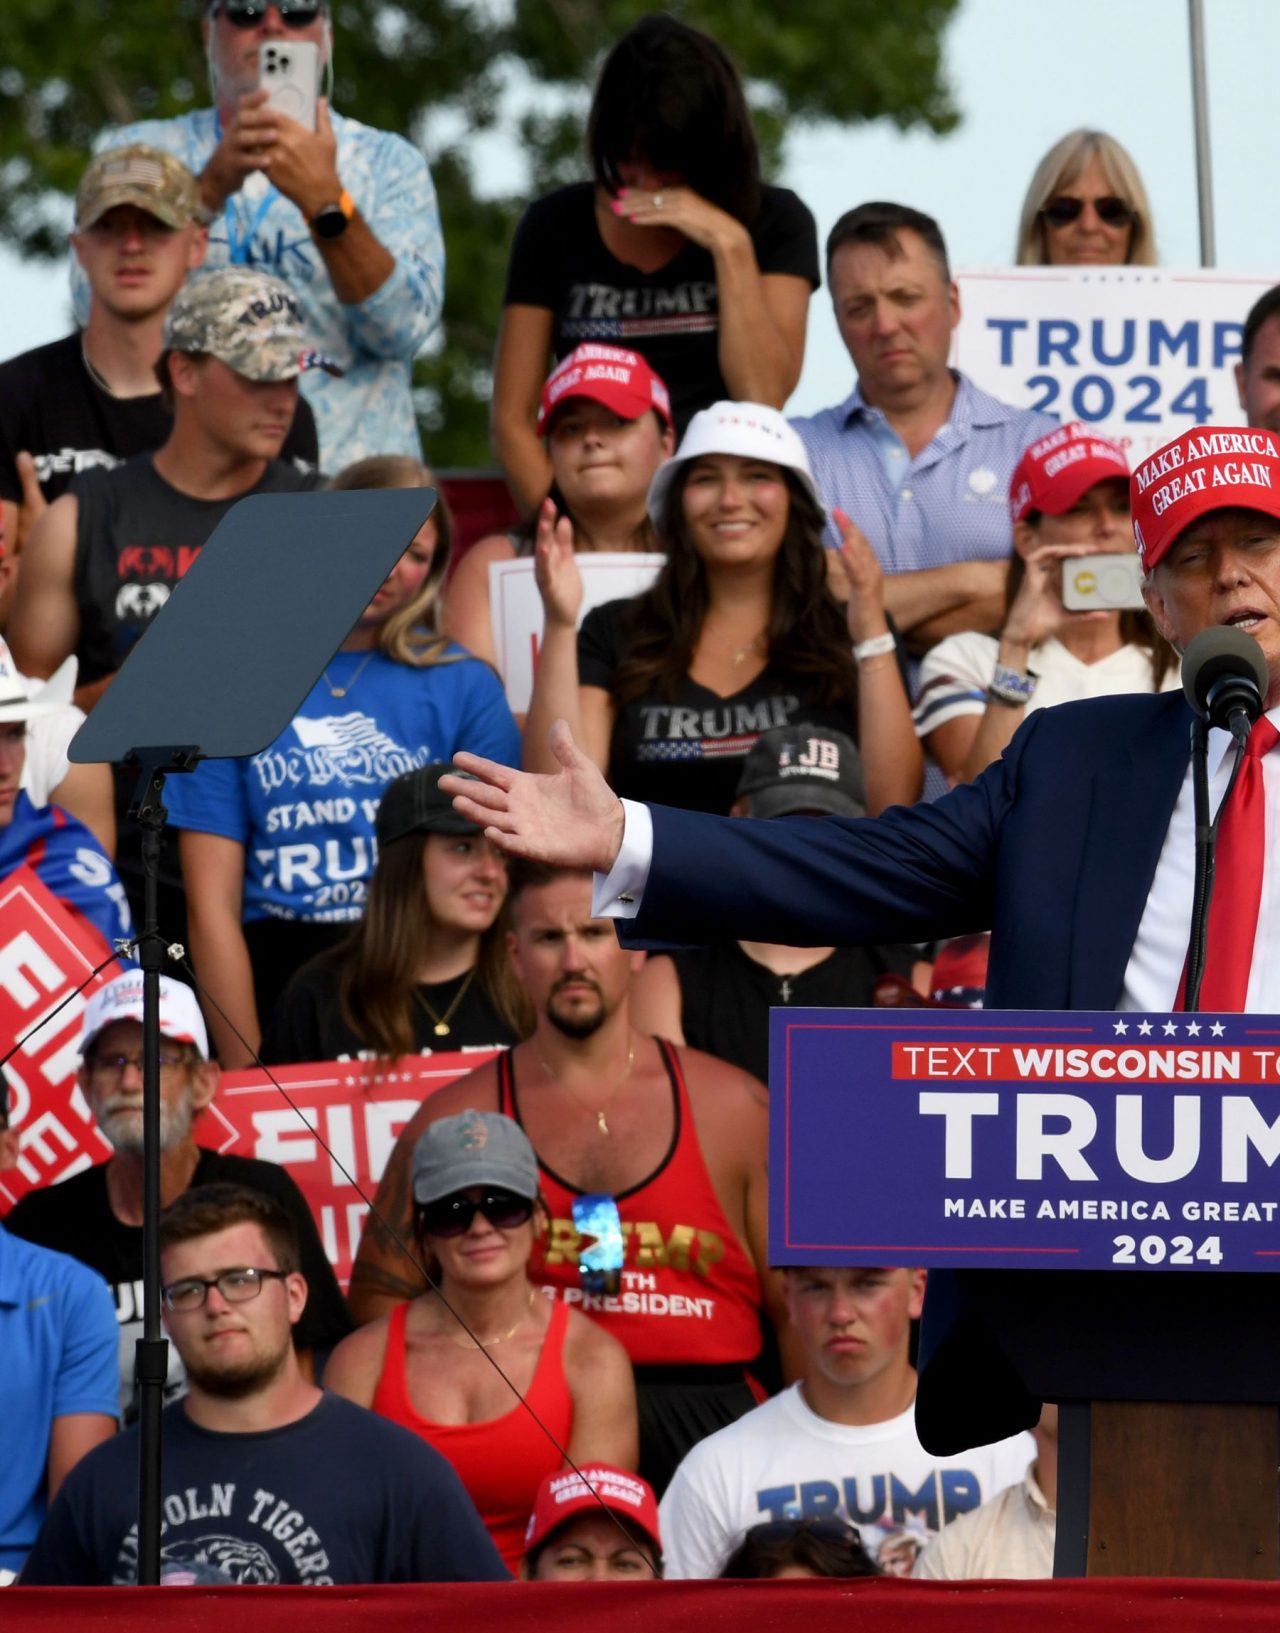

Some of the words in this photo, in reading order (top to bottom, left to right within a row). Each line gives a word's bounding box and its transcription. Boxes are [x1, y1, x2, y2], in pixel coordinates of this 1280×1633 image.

[567, 283, 717, 318] TRUMP
[986, 319, 1244, 367] TRUMP
[1026, 375, 1213, 423] 2024
[1136, 446, 1185, 494] MAKE
[1186, 433, 1279, 462] AMERICA
[1152, 467, 1207, 516] GREAT
[1212, 462, 1272, 488] AGAIN
[640, 696, 800, 739] TRUMP
[266, 797, 356, 834] STAND
[903, 1046, 1000, 1076] TEXT
[1012, 1048, 1240, 1079] WISCONSIN
[252, 1100, 422, 1187] FIR
[943, 1198, 1026, 1219] MAKE
[1036, 1200, 1171, 1221] AMERICA
[1182, 1202, 1278, 1222] GREAT
[1112, 1234, 1223, 1265] 2024
[756, 1468, 982, 1533] TRUMP
